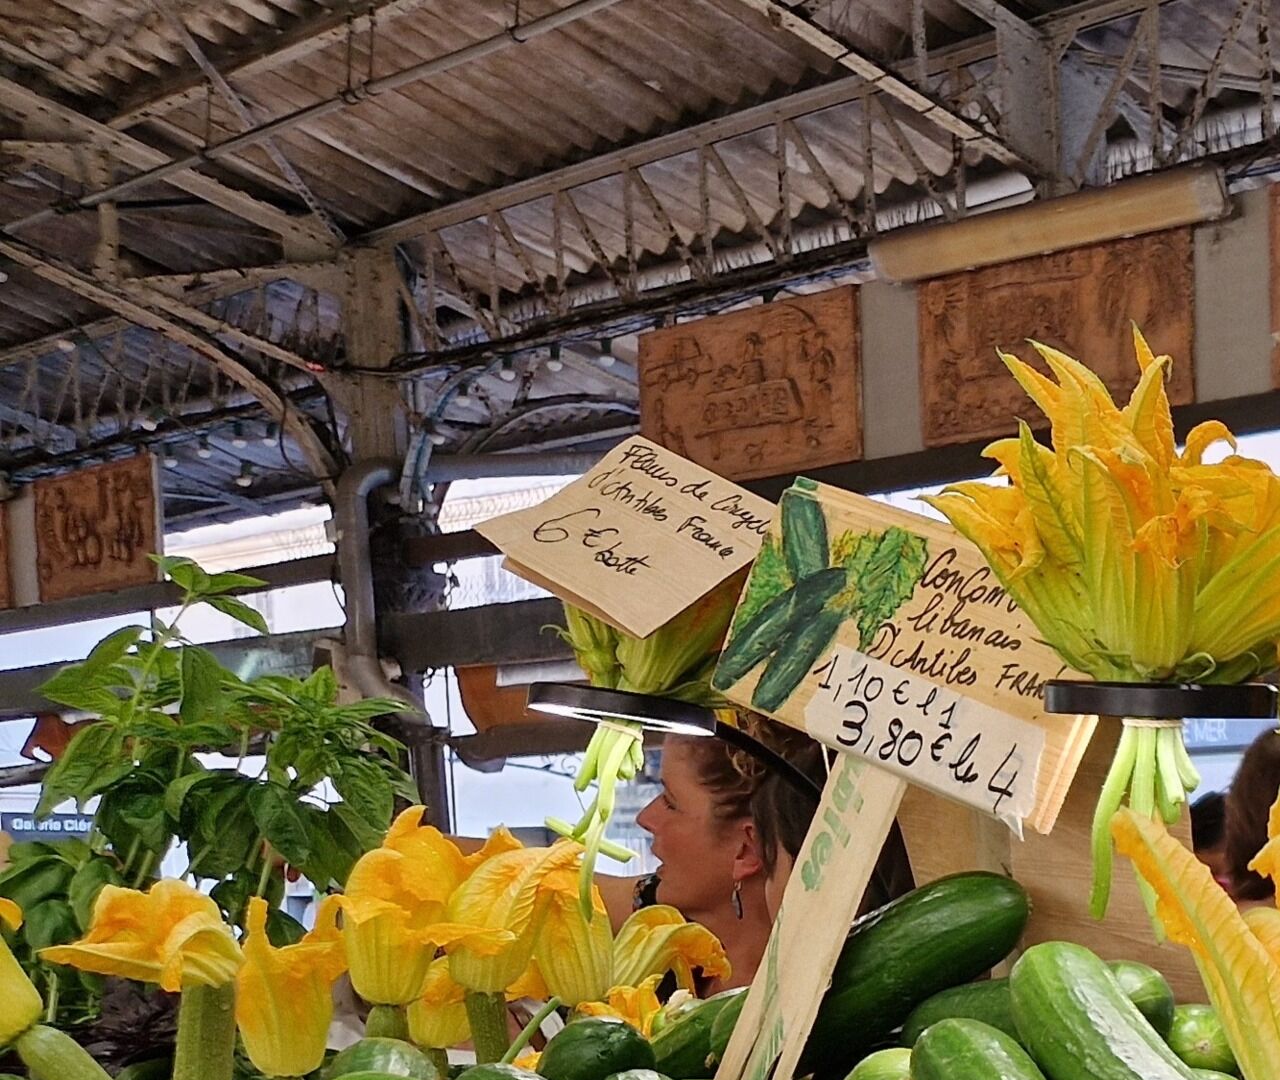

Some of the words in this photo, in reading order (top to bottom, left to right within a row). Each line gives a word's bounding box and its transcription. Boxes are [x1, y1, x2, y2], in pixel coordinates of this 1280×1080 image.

[680, 480, 706, 502] de
[907, 592, 1023, 651] libanais
[891, 679, 911, 706] €
[835, 699, 925, 768] 3,80
[930, 731, 953, 763] €
[987, 742, 1021, 815] 4
